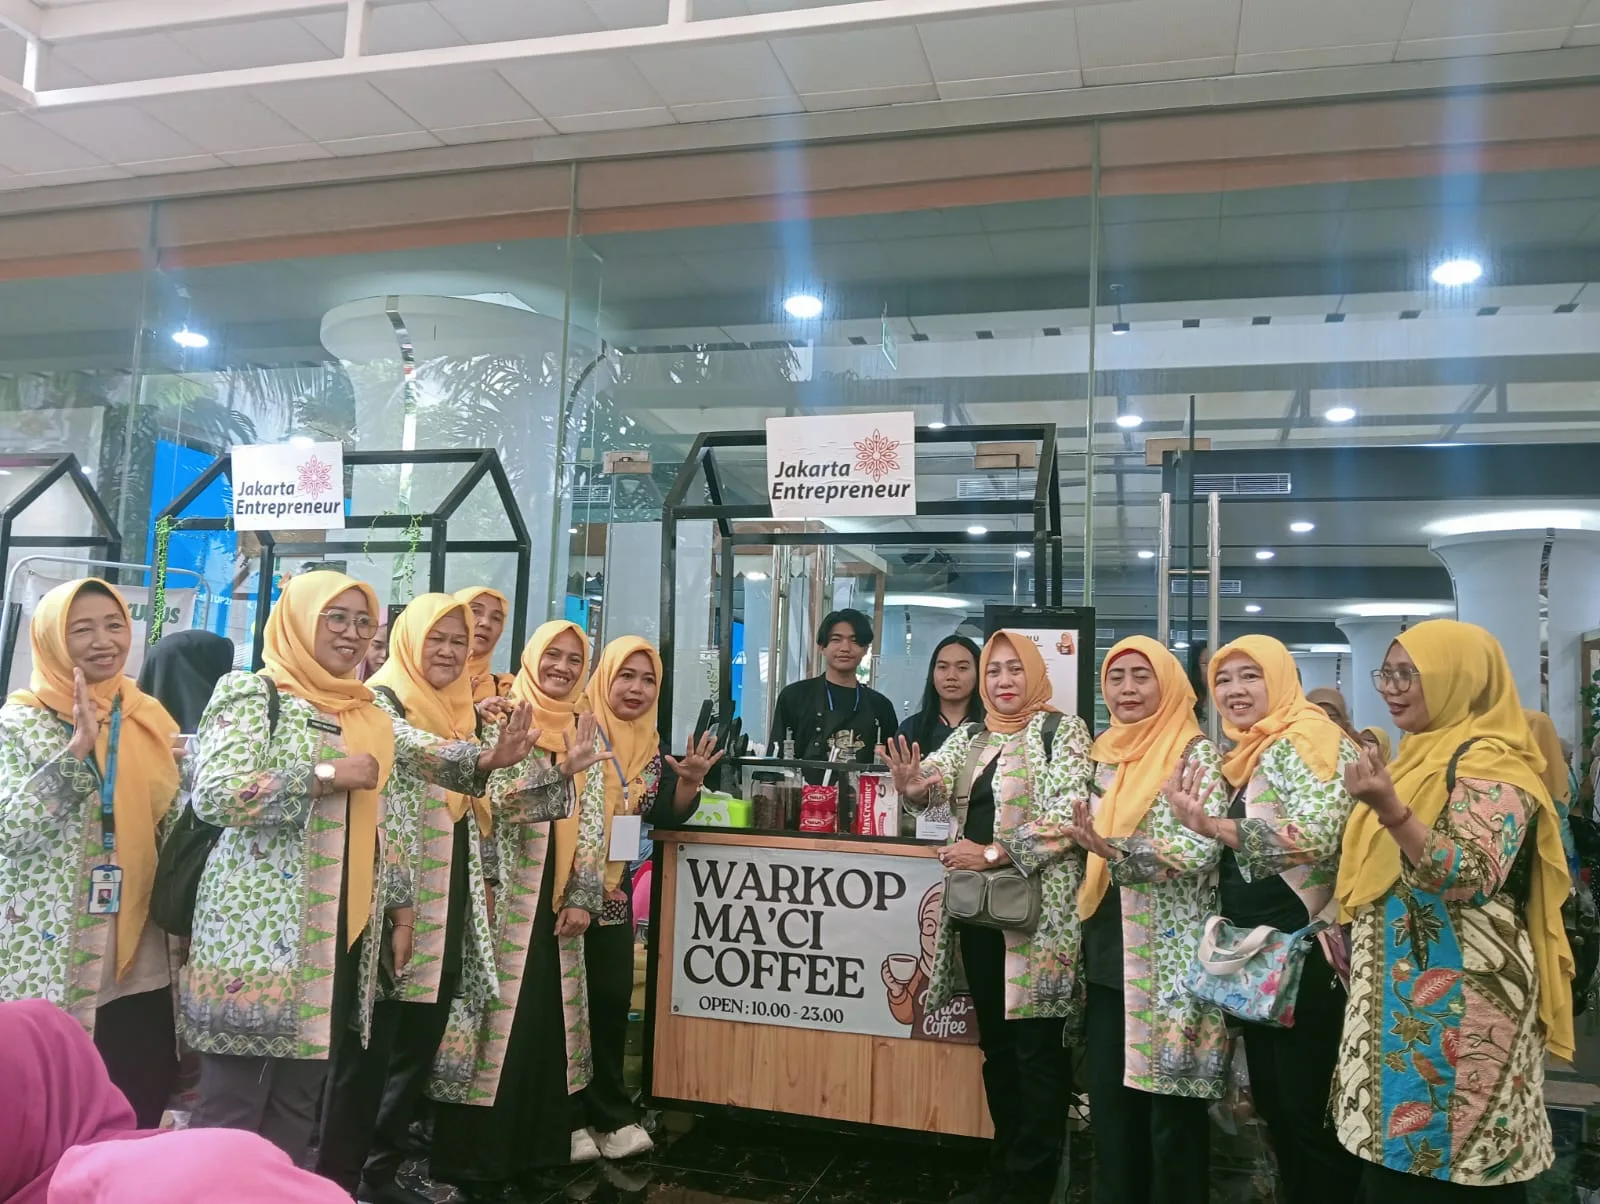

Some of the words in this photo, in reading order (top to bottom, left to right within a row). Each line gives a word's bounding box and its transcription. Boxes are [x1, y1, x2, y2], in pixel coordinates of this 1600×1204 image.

[774, 459, 851, 479] Jakarta
[238, 481, 295, 497] Jakarta
[771, 482, 911, 504] Entrepreneur
[235, 499, 341, 519] Entrepreneur
[686, 858, 907, 911] WARKOP
[692, 901, 824, 951] MA'CI
[683, 944, 865, 999] COFFEE
[800, 1006, 844, 1024] 23.00
[922, 1014, 967, 1038] Coffee
